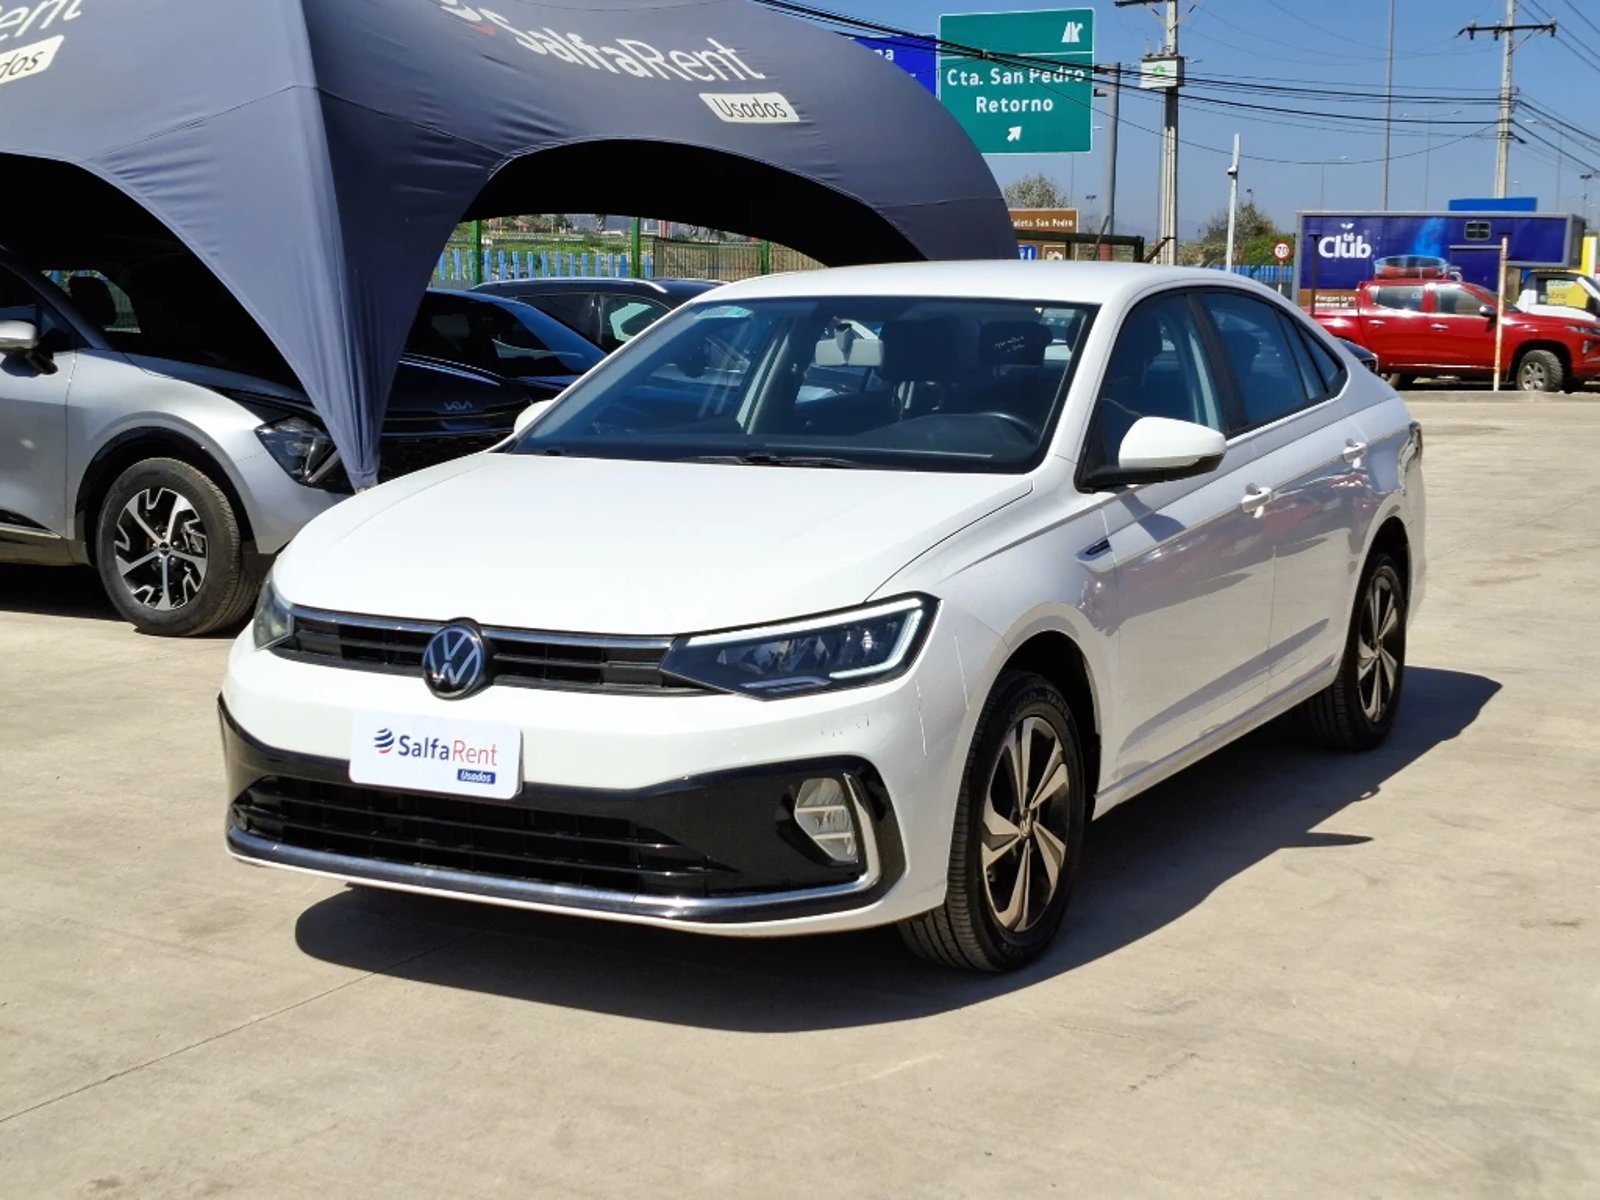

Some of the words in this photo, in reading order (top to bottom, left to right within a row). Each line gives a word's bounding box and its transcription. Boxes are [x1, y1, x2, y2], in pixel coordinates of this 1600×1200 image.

[478, 7, 766, 81] SalfaRent
[946, 69, 984, 86] Cta.
[990, 67, 1024, 85] San
[1029, 65, 1085, 84] Pedro
[712, 97, 787, 119] Usados
[975, 96, 1054, 113] Retorno
[1035, 218, 1050, 228] San
[1052, 218, 1073, 228] Pedro
[1318, 235, 1372, 259] Club
[397, 734, 499, 767] SalfaRent
[459, 769, 493, 783] Usados
